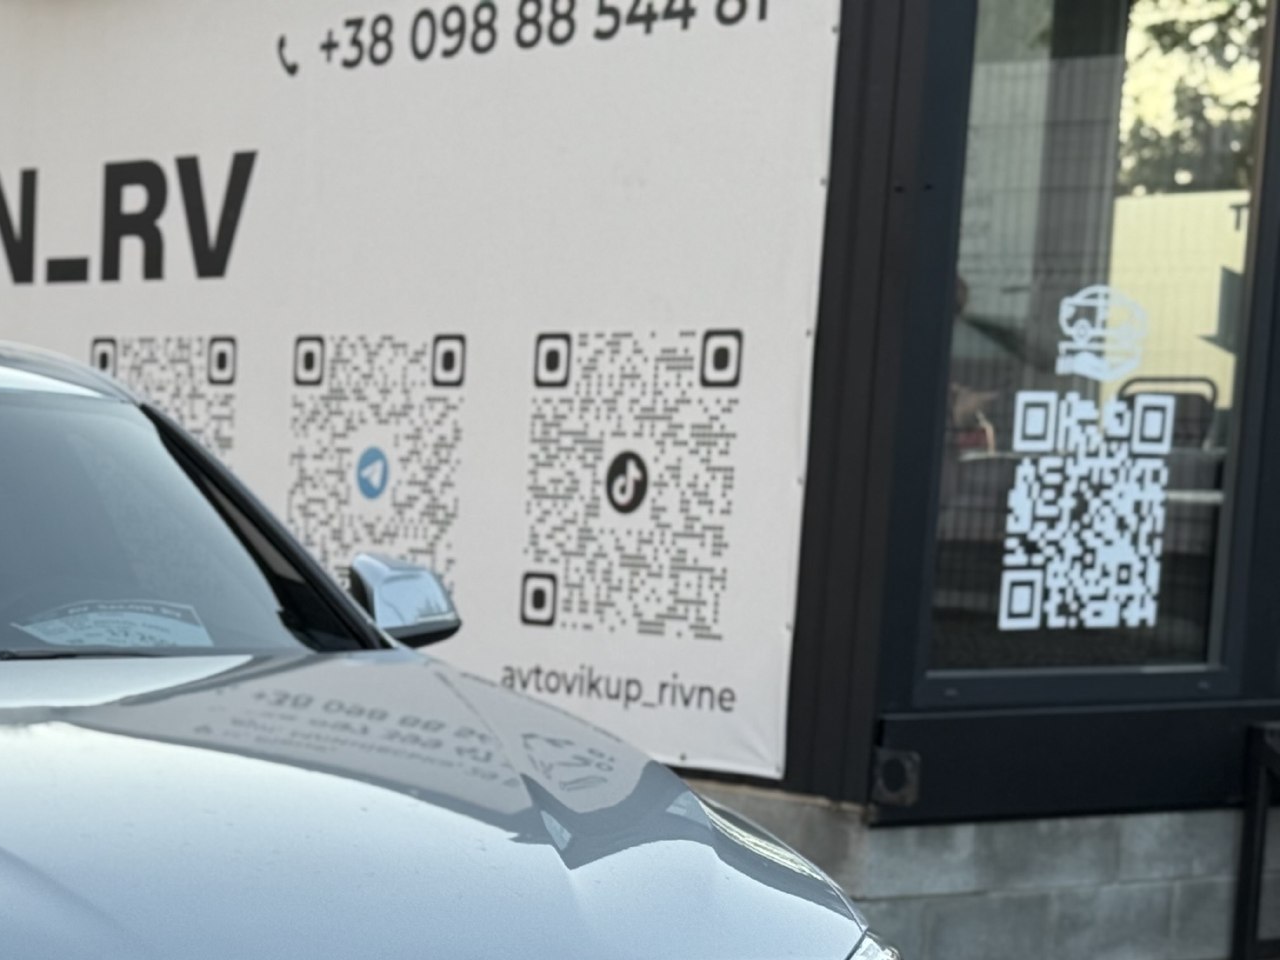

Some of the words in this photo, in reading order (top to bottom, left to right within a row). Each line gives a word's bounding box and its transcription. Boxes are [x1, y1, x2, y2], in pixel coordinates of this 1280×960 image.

[320, 13, 394, 69] +38
[410, 0, 497, 61] 098
[514, 0, 576, 49] 88
[500, 664, 736, 712] avtovikup_rivne
